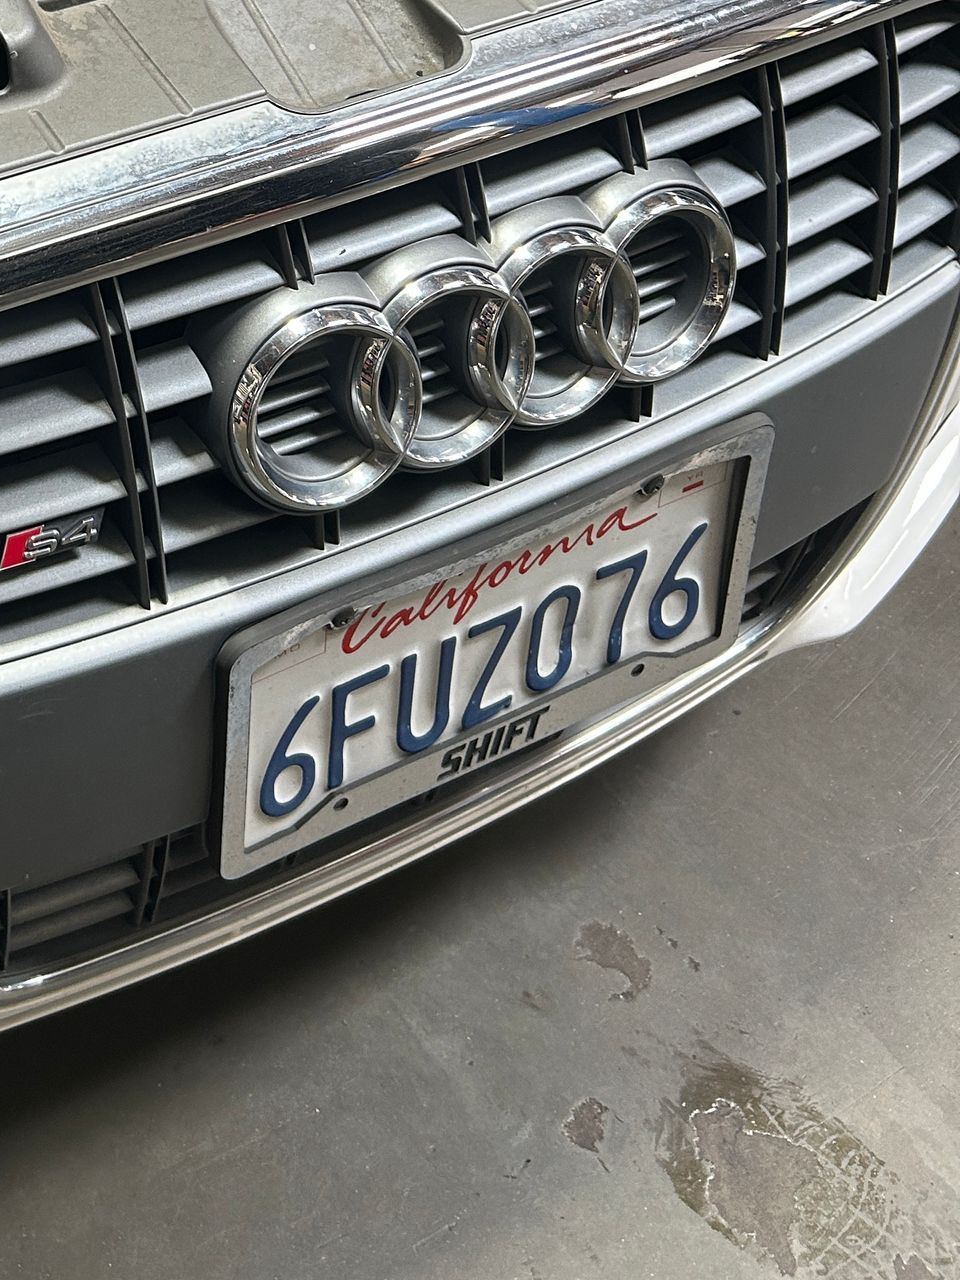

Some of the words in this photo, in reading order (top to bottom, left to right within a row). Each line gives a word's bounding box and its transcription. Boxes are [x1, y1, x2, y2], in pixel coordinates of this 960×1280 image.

[23, 516, 98, 560] S4
[340, 503, 660, 656] California
[258, 521, 709, 818] 6FUZ076
[439, 705, 555, 778] SHIFT
